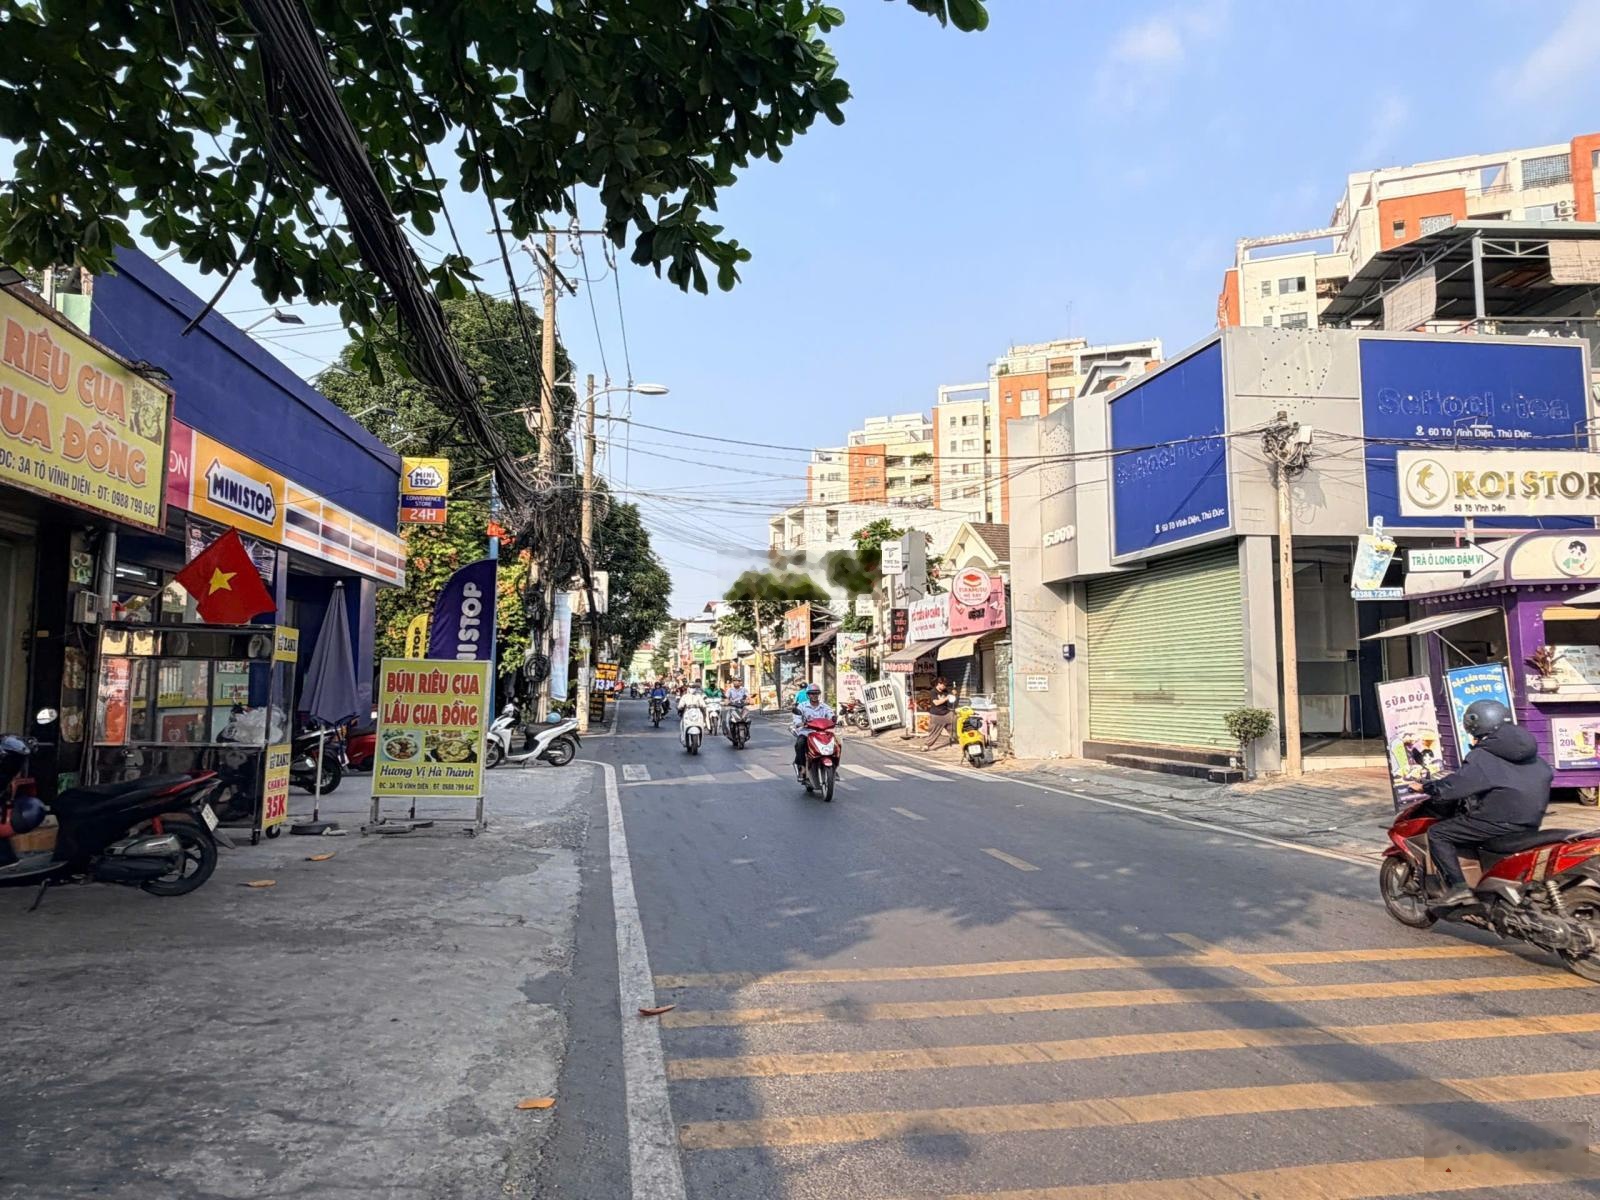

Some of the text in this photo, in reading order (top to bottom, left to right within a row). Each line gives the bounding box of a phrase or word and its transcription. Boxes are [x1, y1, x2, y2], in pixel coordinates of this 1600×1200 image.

[3, 318, 126, 423] RIÊU CUA
[0, 386, 146, 486] UA ĐỒNG
[1428, 428, 1439, 437] 60
[1441, 428, 1452, 437] Tô
[1497, 428, 1512, 438] Thủ
[1514, 428, 1531, 439] Đức
[18, 456, 30, 475] 3A
[97, 485, 110, 503] ĐT:
[112, 489, 129, 509] 0988
[131, 496, 143, 513] 799
[143, 503, 156, 518] 642
[213, 472, 273, 517] MINISTOP
[414, 478, 436, 486] STOP
[1454, 470, 1515, 500] KOI
[410, 508, 436, 521] 24H
[1201, 511, 1212, 520] Thủ
[1212, 507, 1225, 517] Đức
[1435, 555, 1455, 565] LONG
[412, 627, 421, 658] STOP
[386, 668, 480, 695] BÚN RIÊU CUA
[383, 696, 477, 726] LẨU CUA ĐỒNG
[872, 715, 886, 725] NAM
[380, 765, 474, 779] Hương Vị Hà Thành
[266, 793, 286, 819] 35K
